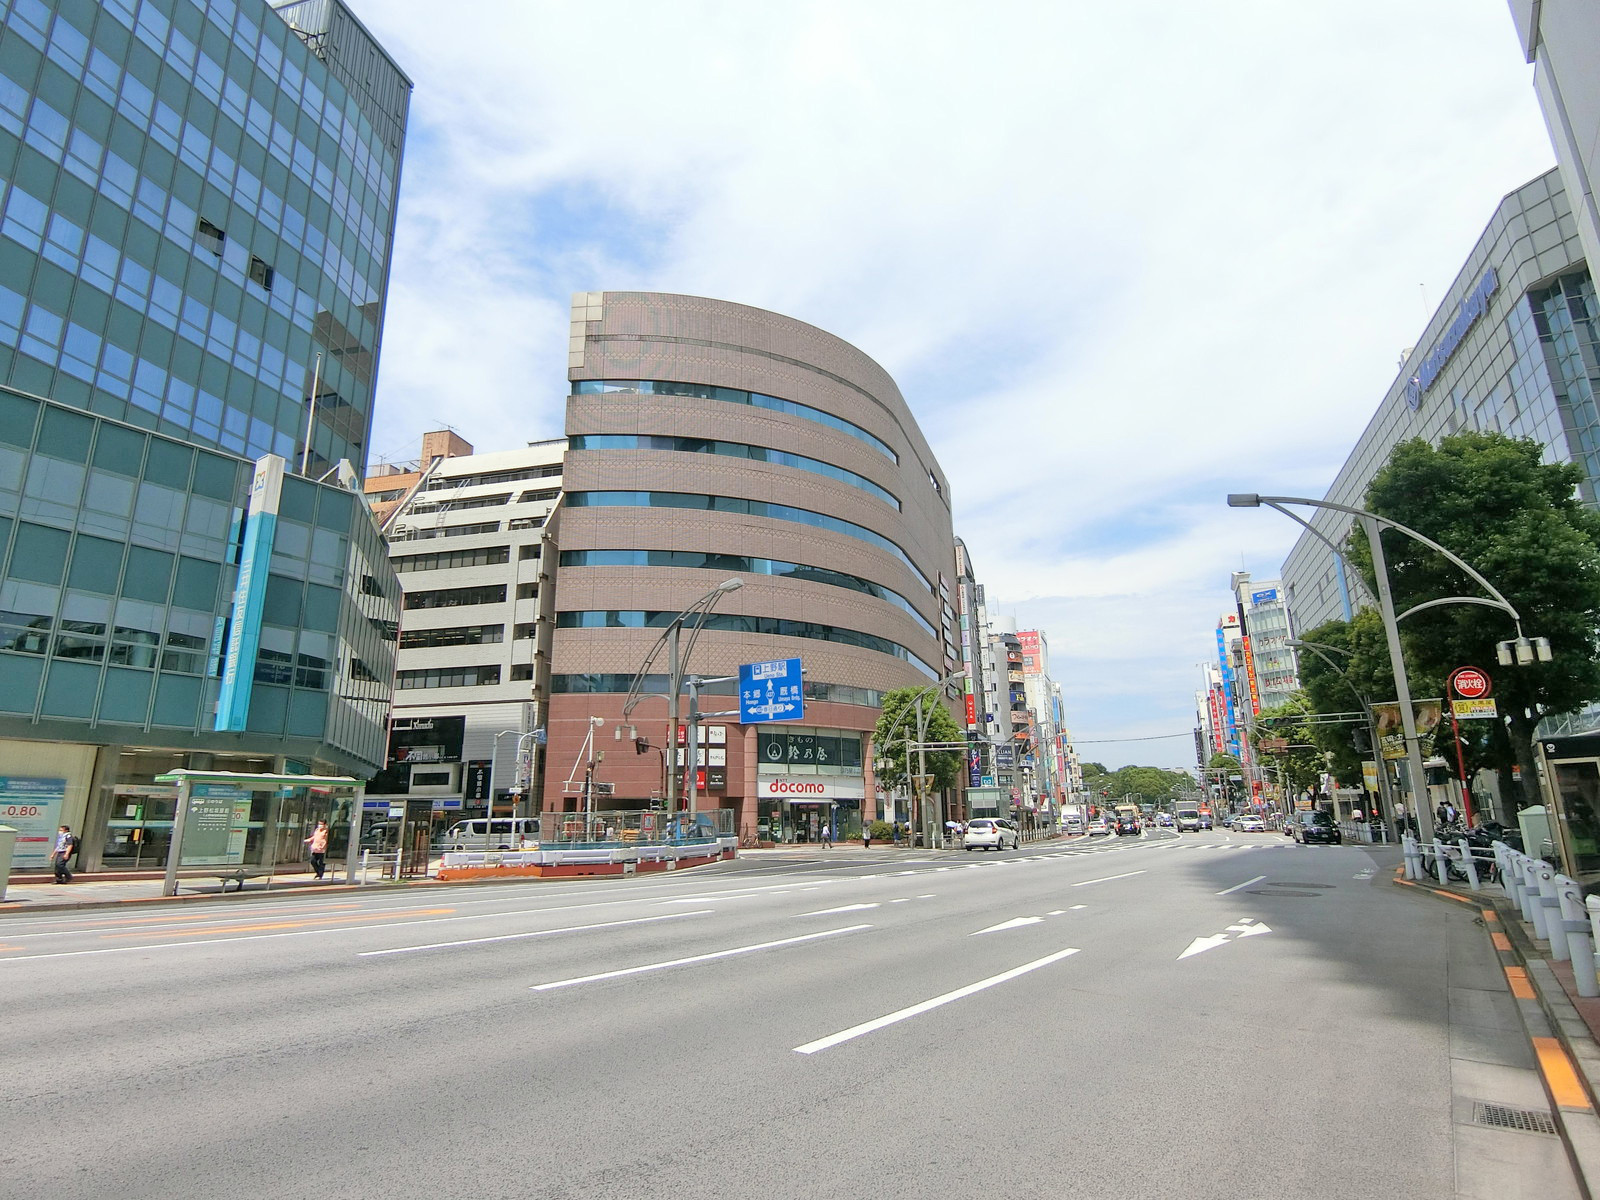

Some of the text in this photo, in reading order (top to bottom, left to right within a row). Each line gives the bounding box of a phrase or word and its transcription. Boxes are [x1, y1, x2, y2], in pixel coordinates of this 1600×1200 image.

[762, 662, 786, 674] 上野駅
[1457, 678, 1483, 689] 消火栓
[770, 779, 825, 793] docomo
[8, 806, 37, 816] 0.80
